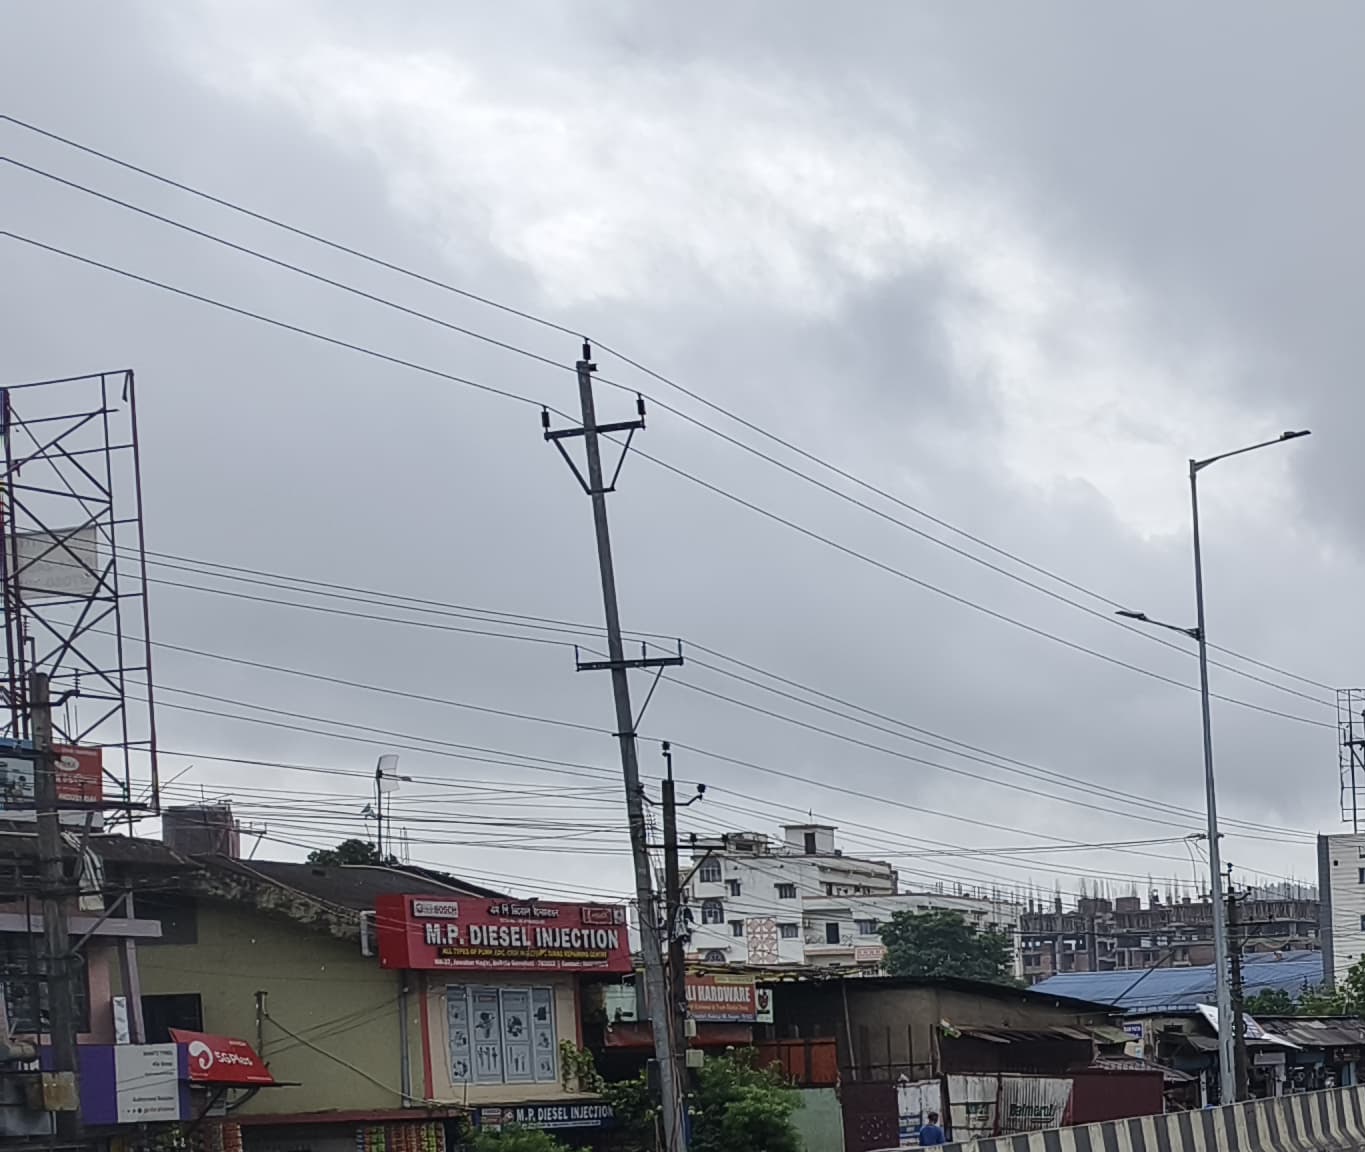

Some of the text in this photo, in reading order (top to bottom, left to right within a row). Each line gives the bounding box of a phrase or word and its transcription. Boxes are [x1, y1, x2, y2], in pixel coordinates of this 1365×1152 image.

[425, 922, 619, 950] M.P. DIESEL INJECTION
[698, 985, 751, 1002] HARDWARE
[516, 1104, 614, 1122] M.P. DIESEL INJECTION
